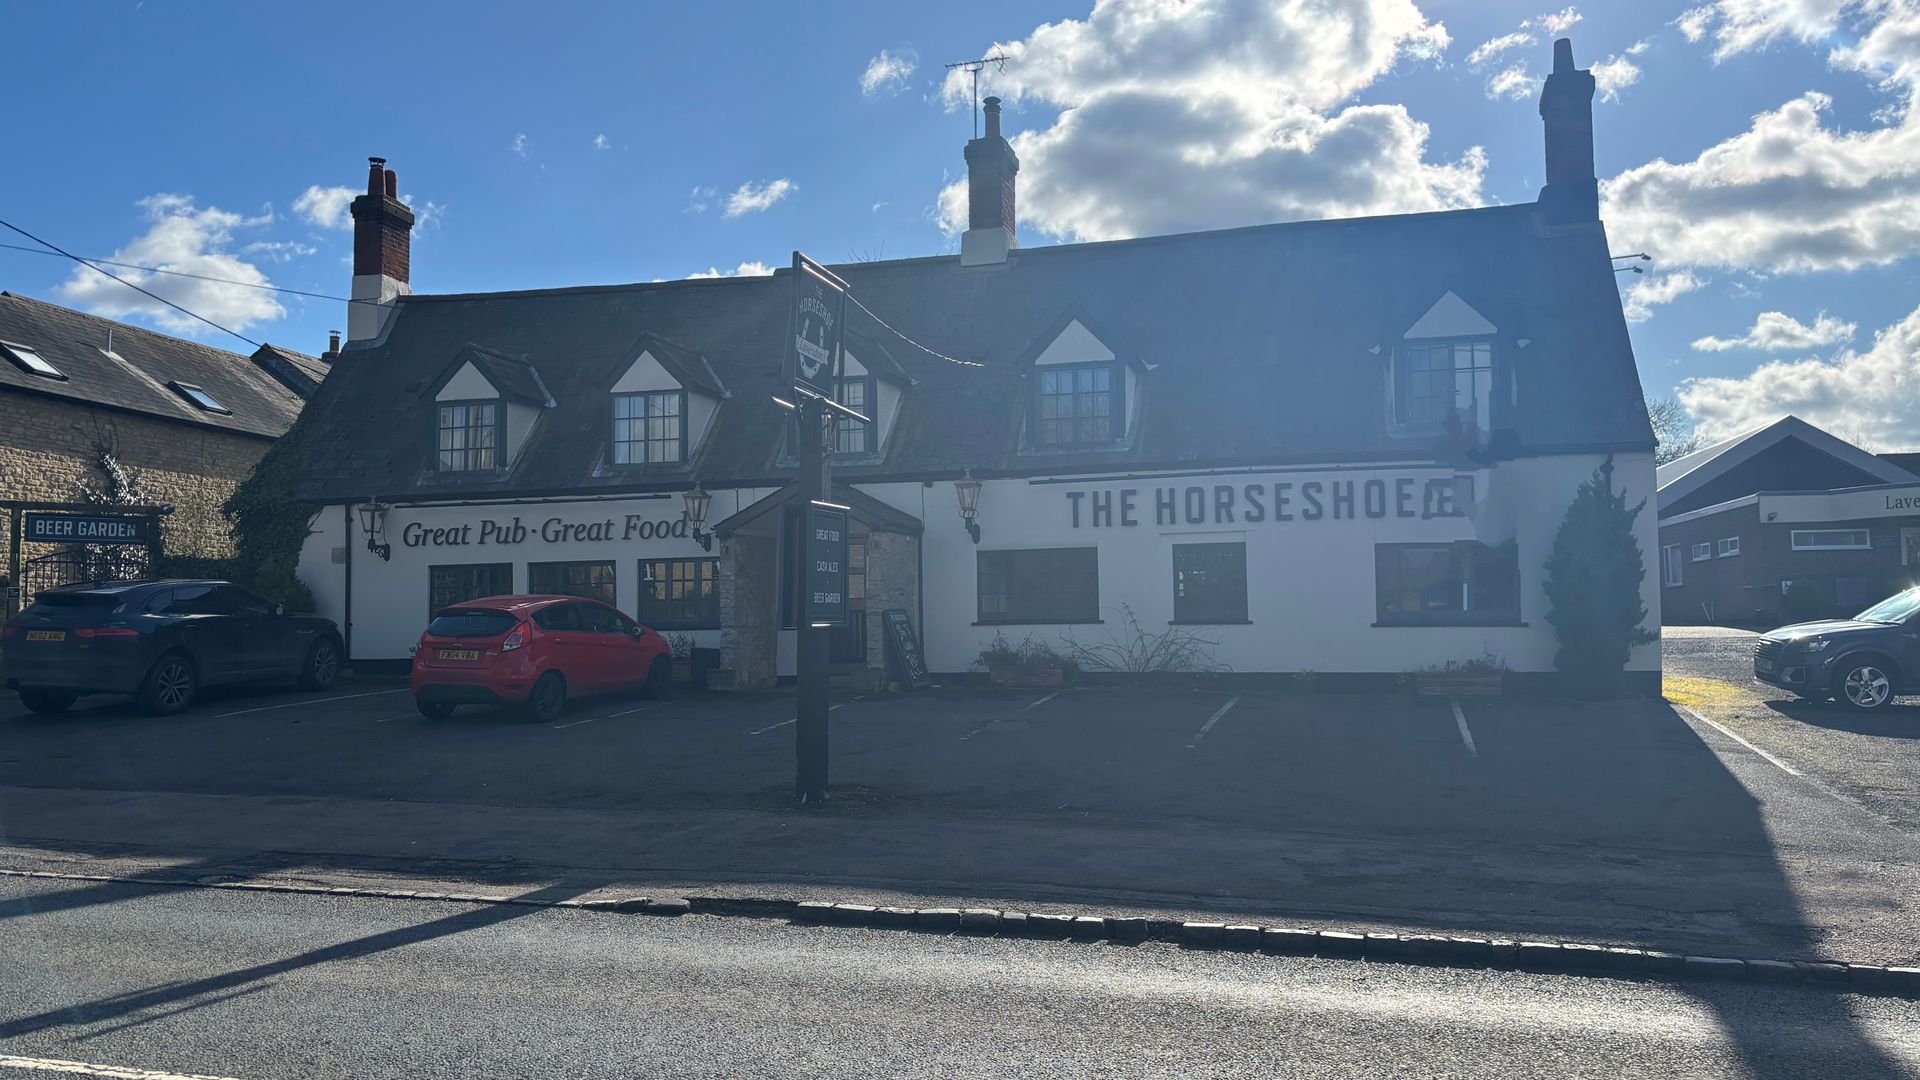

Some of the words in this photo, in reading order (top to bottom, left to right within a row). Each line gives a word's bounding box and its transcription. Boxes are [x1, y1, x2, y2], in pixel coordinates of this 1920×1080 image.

[815, 285, 824, 299] THE
[800, 297, 834, 331] HORSESHOE
[1066, 488, 1138, 528] THE
[1885, 495, 1920, 510] Lave
[35, 519, 73, 536] BEER
[78, 522, 136, 537] GARDEN
[402, 521, 471, 547] Great
[477, 516, 526, 546] Pub
[541, 517, 615, 543] Great
[622, 510, 689, 541] Food
[816, 529, 829, 541] GREAT
[829, 530, 840, 542] FOOD
[816, 561, 828, 572] CASK
[828, 562, 839, 573] ALES
[814, 592, 825, 604] BEER
[825, 592, 841, 604] GARDEN
